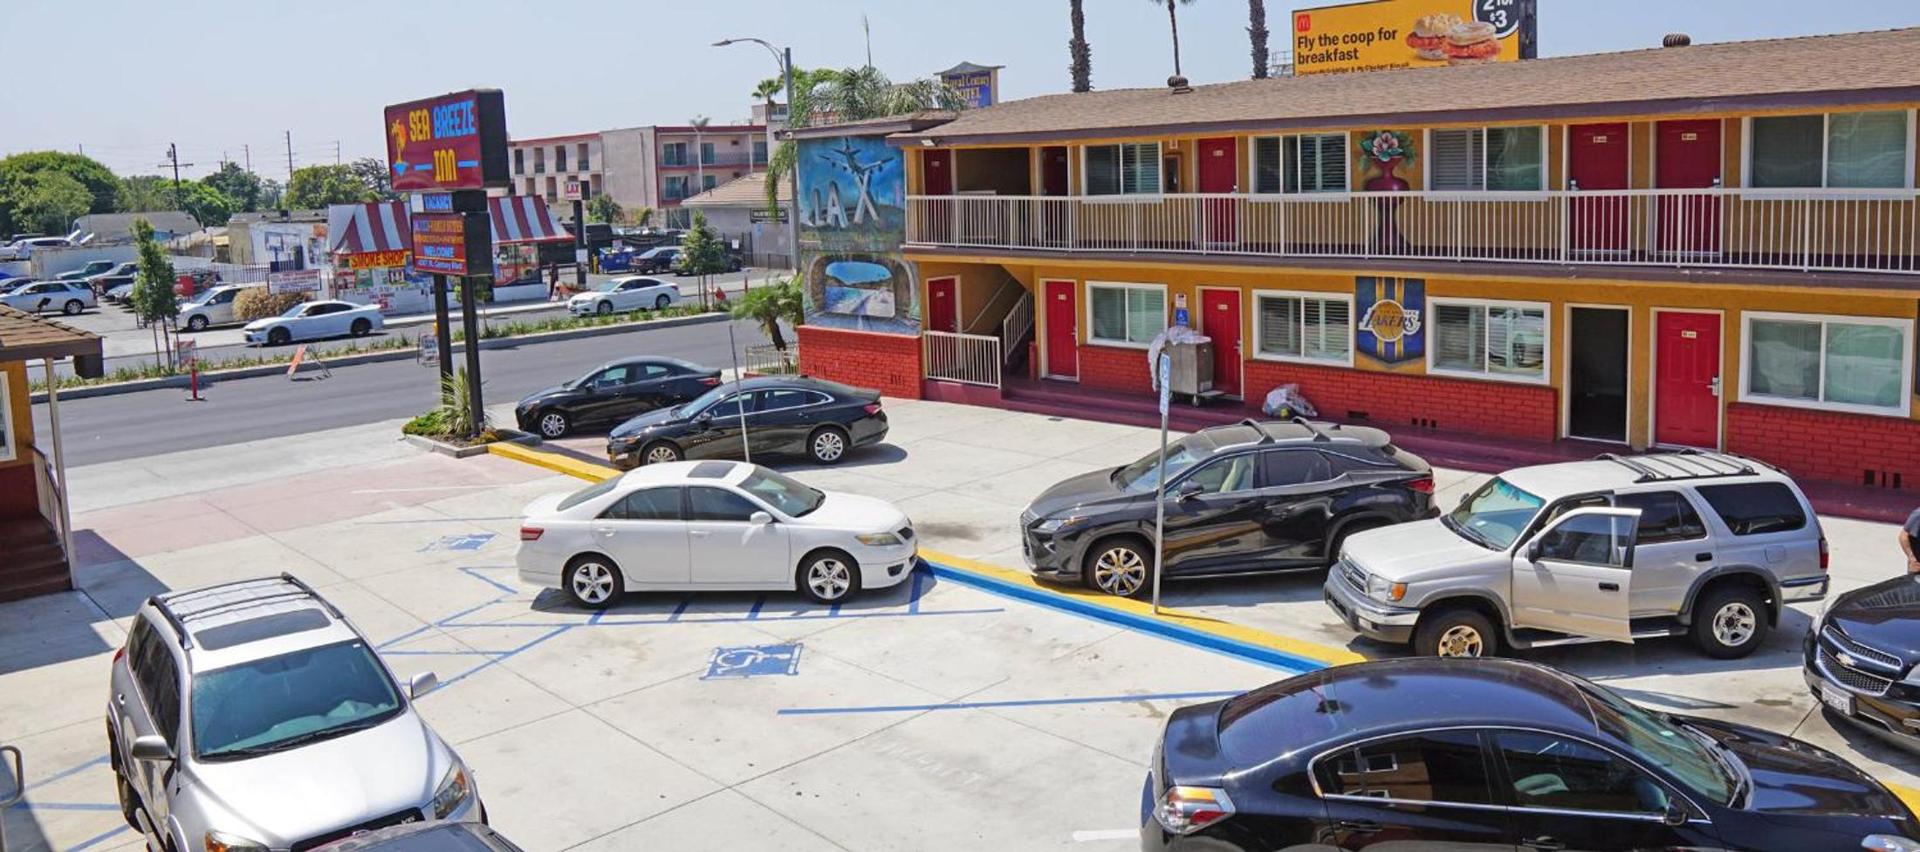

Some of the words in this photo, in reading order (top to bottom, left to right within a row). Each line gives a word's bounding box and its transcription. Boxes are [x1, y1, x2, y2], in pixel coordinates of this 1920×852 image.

[1489, 10, 1507, 28] $3
[1297, 35, 1315, 51] Fly
[1318, 33, 1340, 47] the
[1342, 31, 1375, 46] coop
[1378, 27, 1398, 40] for
[1297, 48, 1359, 65] breakfast
[409, 109, 430, 142] SEA
[433, 100, 476, 139] BREEZE
[434, 149, 457, 182] INN
[566, 184, 580, 195] LAX
[812, 173, 880, 228] LAX
[351, 253, 381, 268] SMOKE
[383, 251, 405, 266] SHOP
[424, 245, 455, 258] WELCOME
